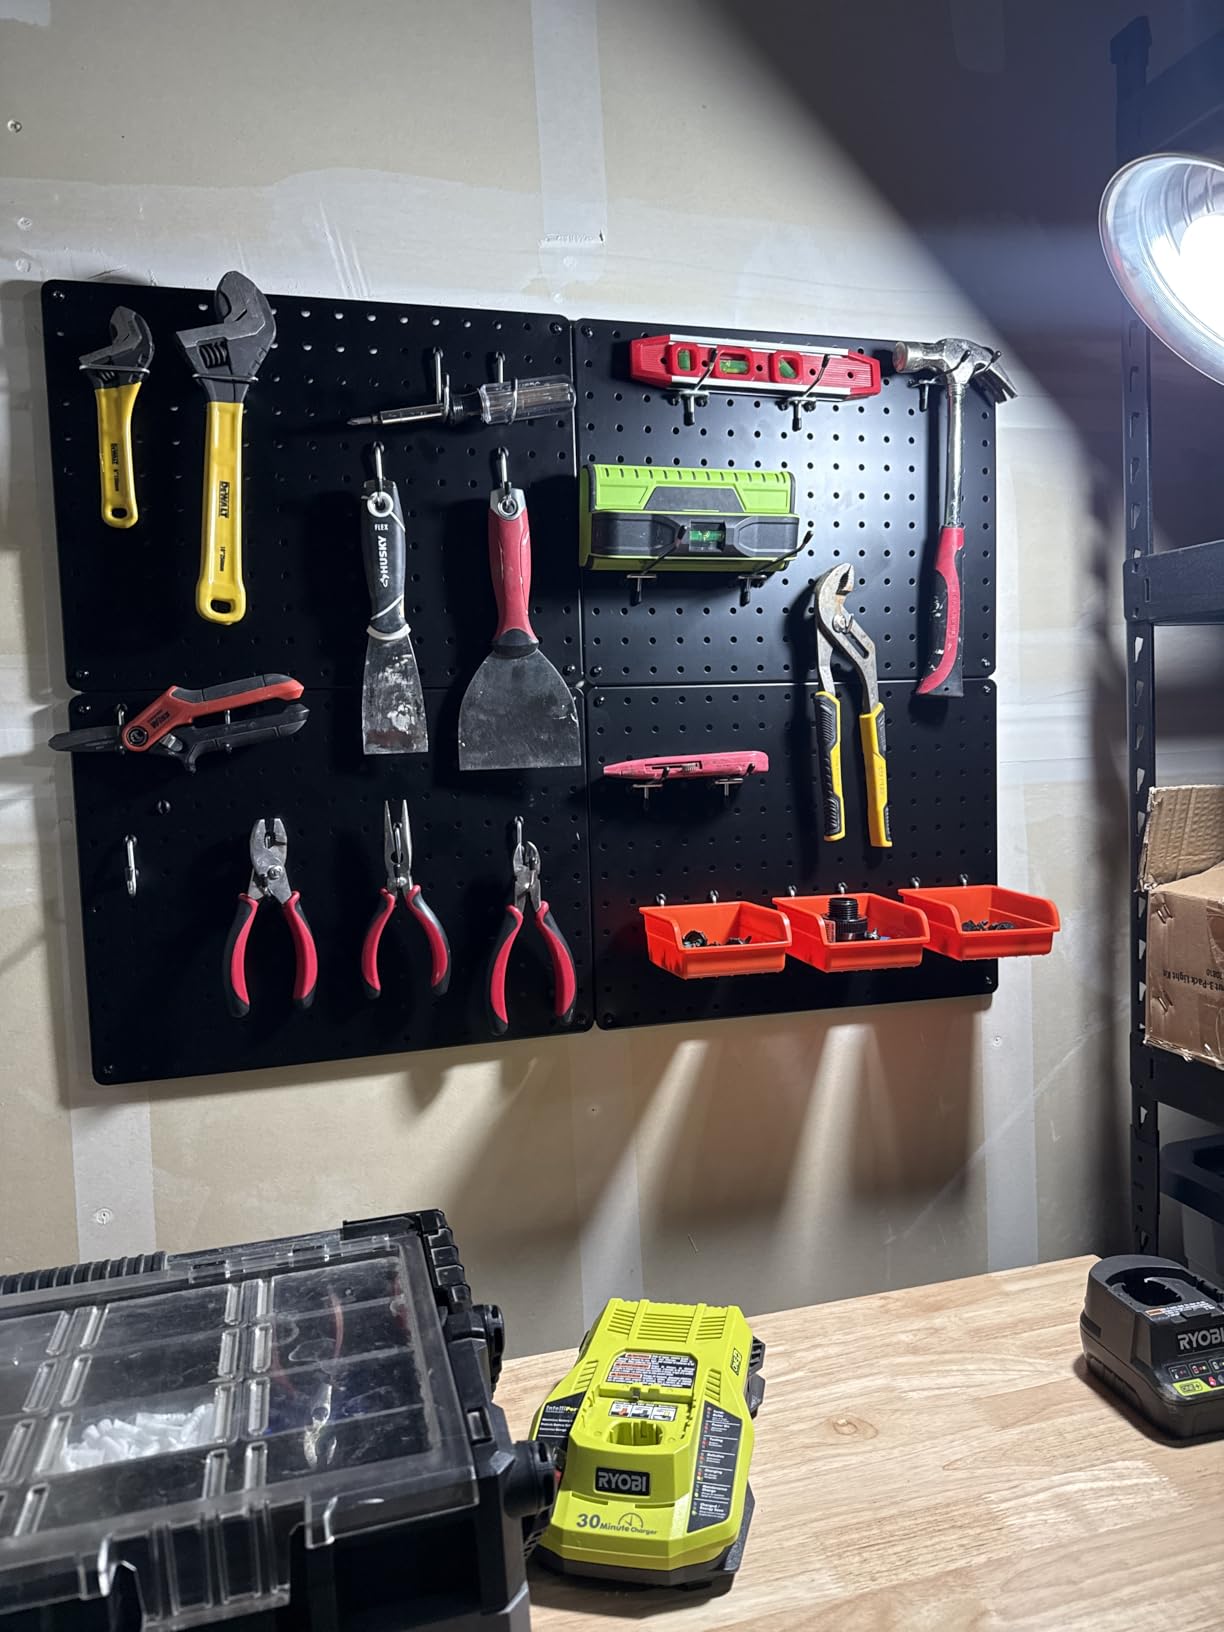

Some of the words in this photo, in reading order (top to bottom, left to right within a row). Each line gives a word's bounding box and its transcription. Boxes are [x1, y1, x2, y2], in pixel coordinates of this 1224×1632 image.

[374, 523, 389, 531] FLEX
[377, 535, 389, 574] HUSKY
[1172, 971, 1190, 984] Light
[597, 1471, 647, 1492] RYOBI
[576, 1513, 600, 1529] 30
[600, 1522, 630, 1532] Minute
[630, 1526, 657, 1535] Charger
